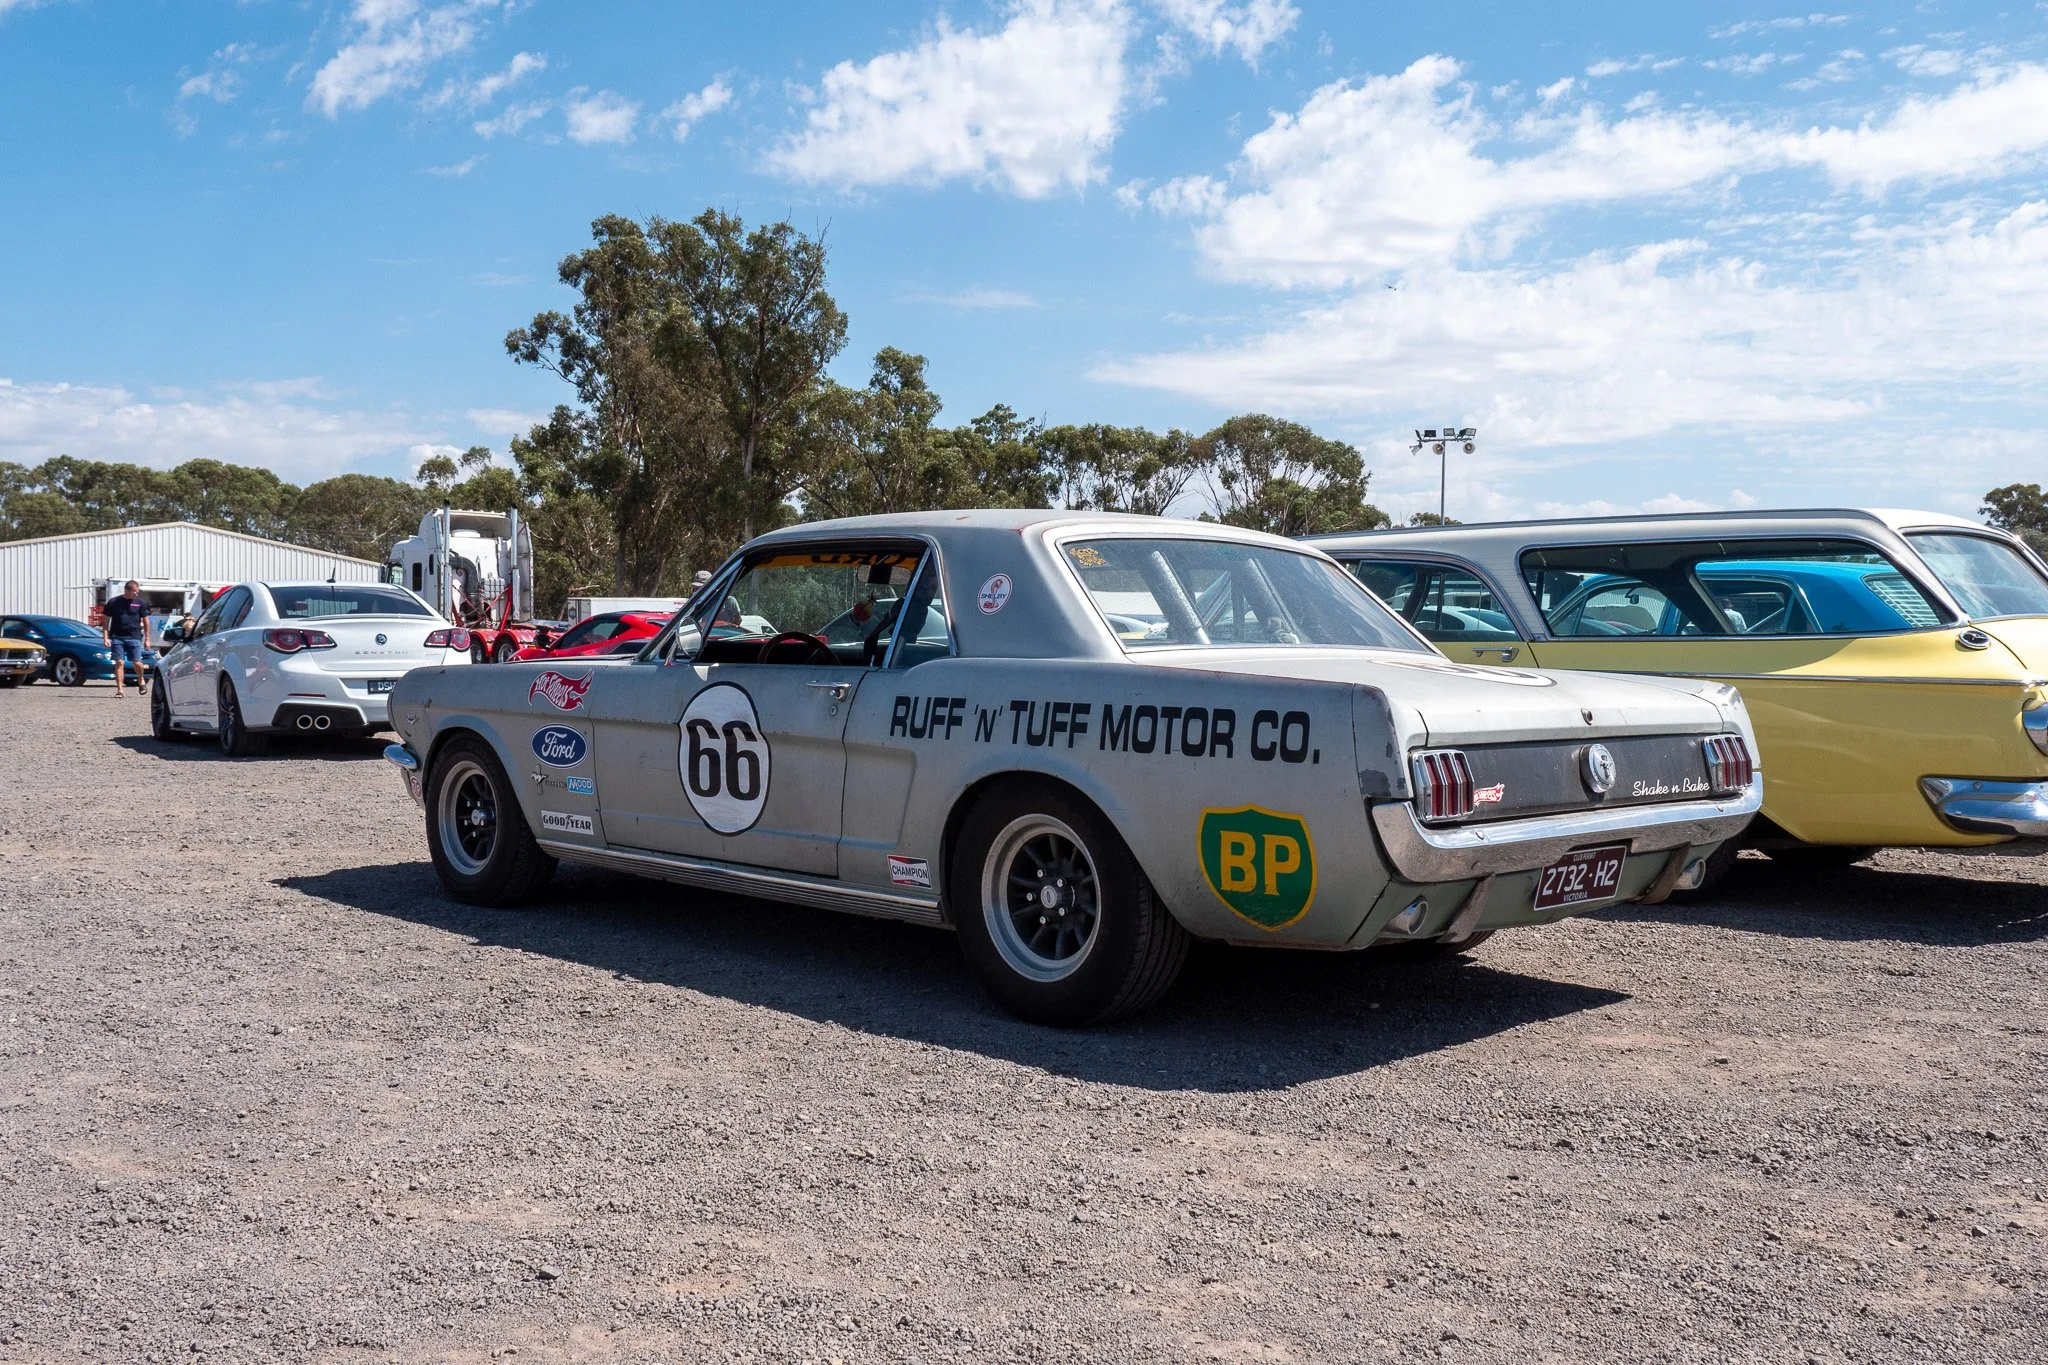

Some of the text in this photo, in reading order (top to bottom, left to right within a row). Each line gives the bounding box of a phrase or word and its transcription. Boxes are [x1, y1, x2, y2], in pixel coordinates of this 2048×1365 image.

[889, 696, 1321, 765] RUFF 'N' TUFF MOTOR CO.
[541, 731, 576, 759] Ford
[686, 718, 761, 801] 66
[568, 778, 592, 791] MOOD
[1632, 777, 1710, 797] Shake n Bake
[891, 864, 929, 879] CHAMPION
[1220, 830, 1301, 896] BP
